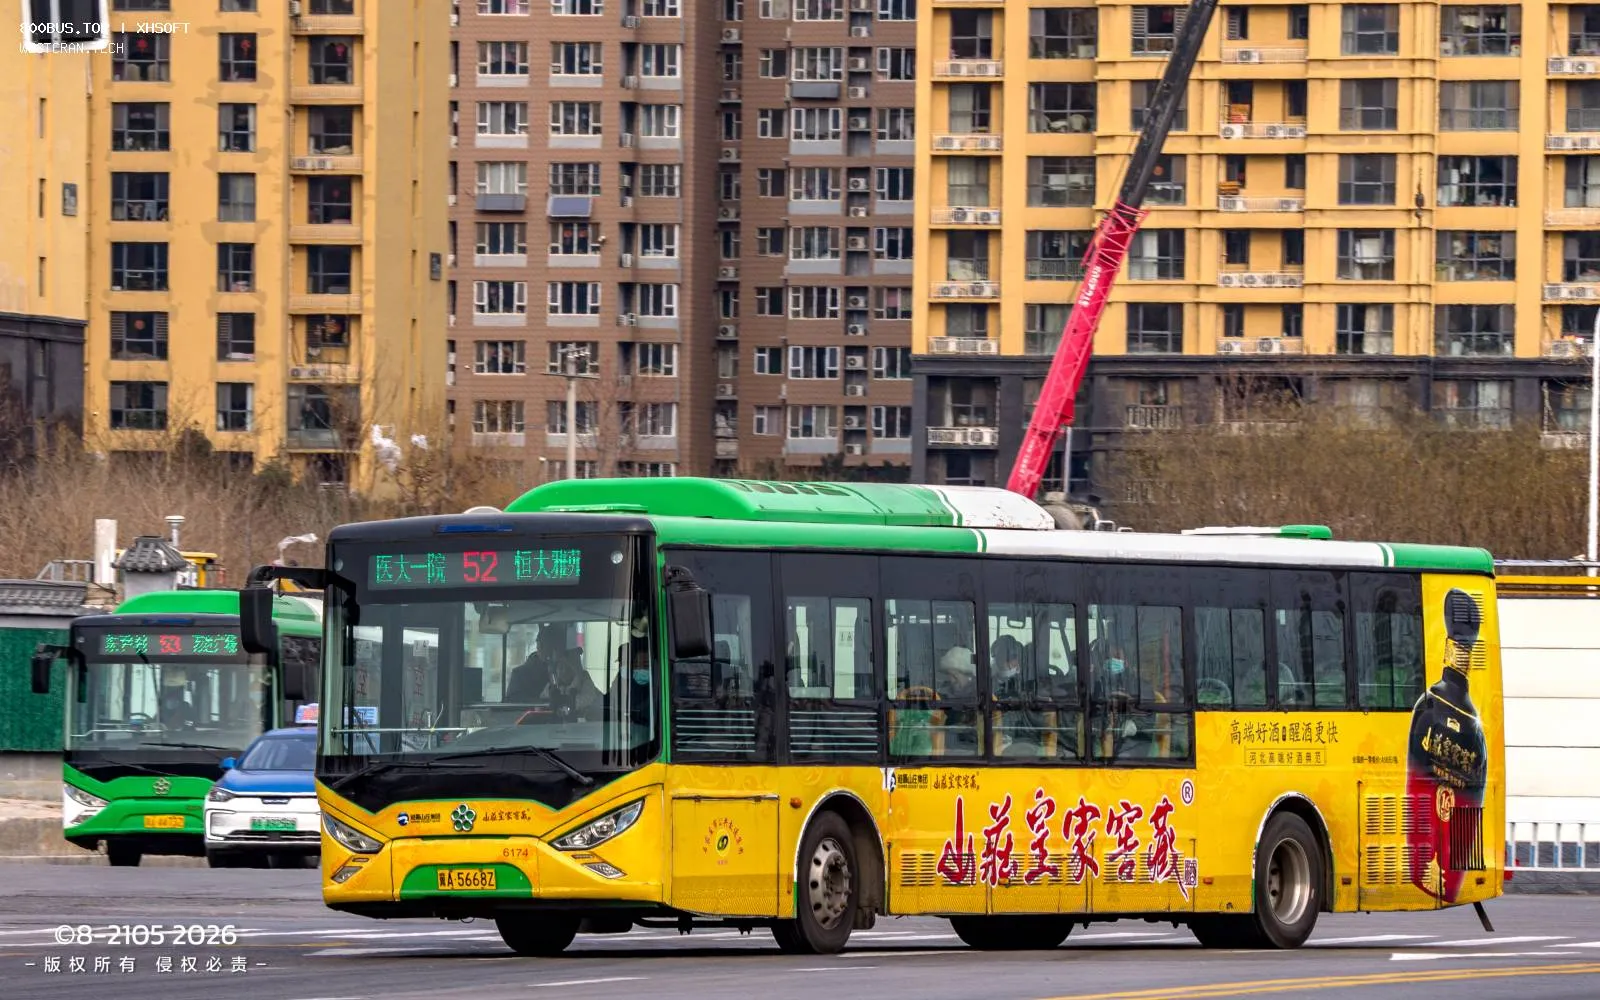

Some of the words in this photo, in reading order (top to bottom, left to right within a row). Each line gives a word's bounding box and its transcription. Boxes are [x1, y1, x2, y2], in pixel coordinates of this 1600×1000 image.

[376, 553, 446, 584] 医大一院
[463, 552, 497, 582] 52
[1230, 720, 1279, 745] 高端好酒
[1289, 720, 1339, 744] 醒酒更快
[503, 848, 528, 857] 6174
